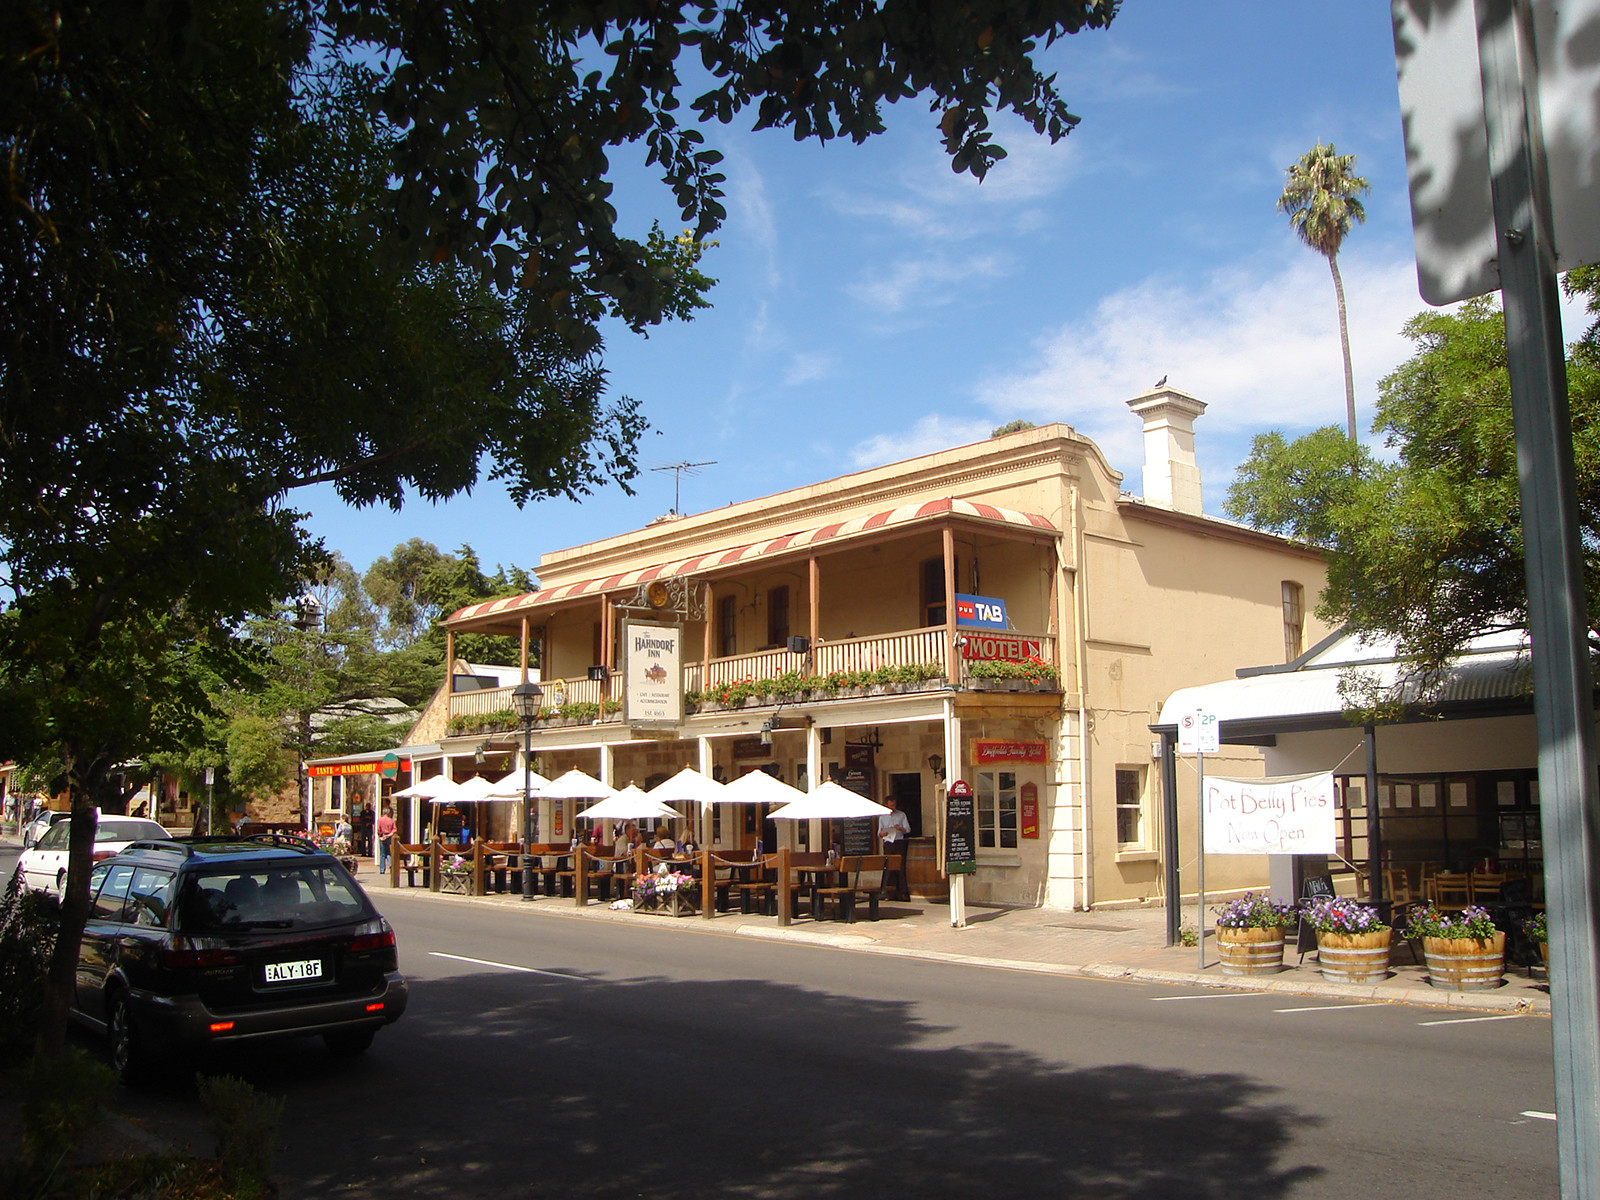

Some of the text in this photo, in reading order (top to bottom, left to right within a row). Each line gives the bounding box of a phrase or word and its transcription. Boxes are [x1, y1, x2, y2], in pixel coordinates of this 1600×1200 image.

[975, 602, 1003, 623] TAB
[635, 636, 675, 654] HAHNDORF
[648, 649, 660, 658] INN
[968, 637, 1025, 660] MOTEL
[1201, 714, 1216, 725] 2P
[316, 766, 334, 775] TASTE
[341, 763, 378, 774] HAHNDORF
[1208, 784, 1327, 818] Pot Belly Pies
[1228, 820, 1305, 849] Now Open
